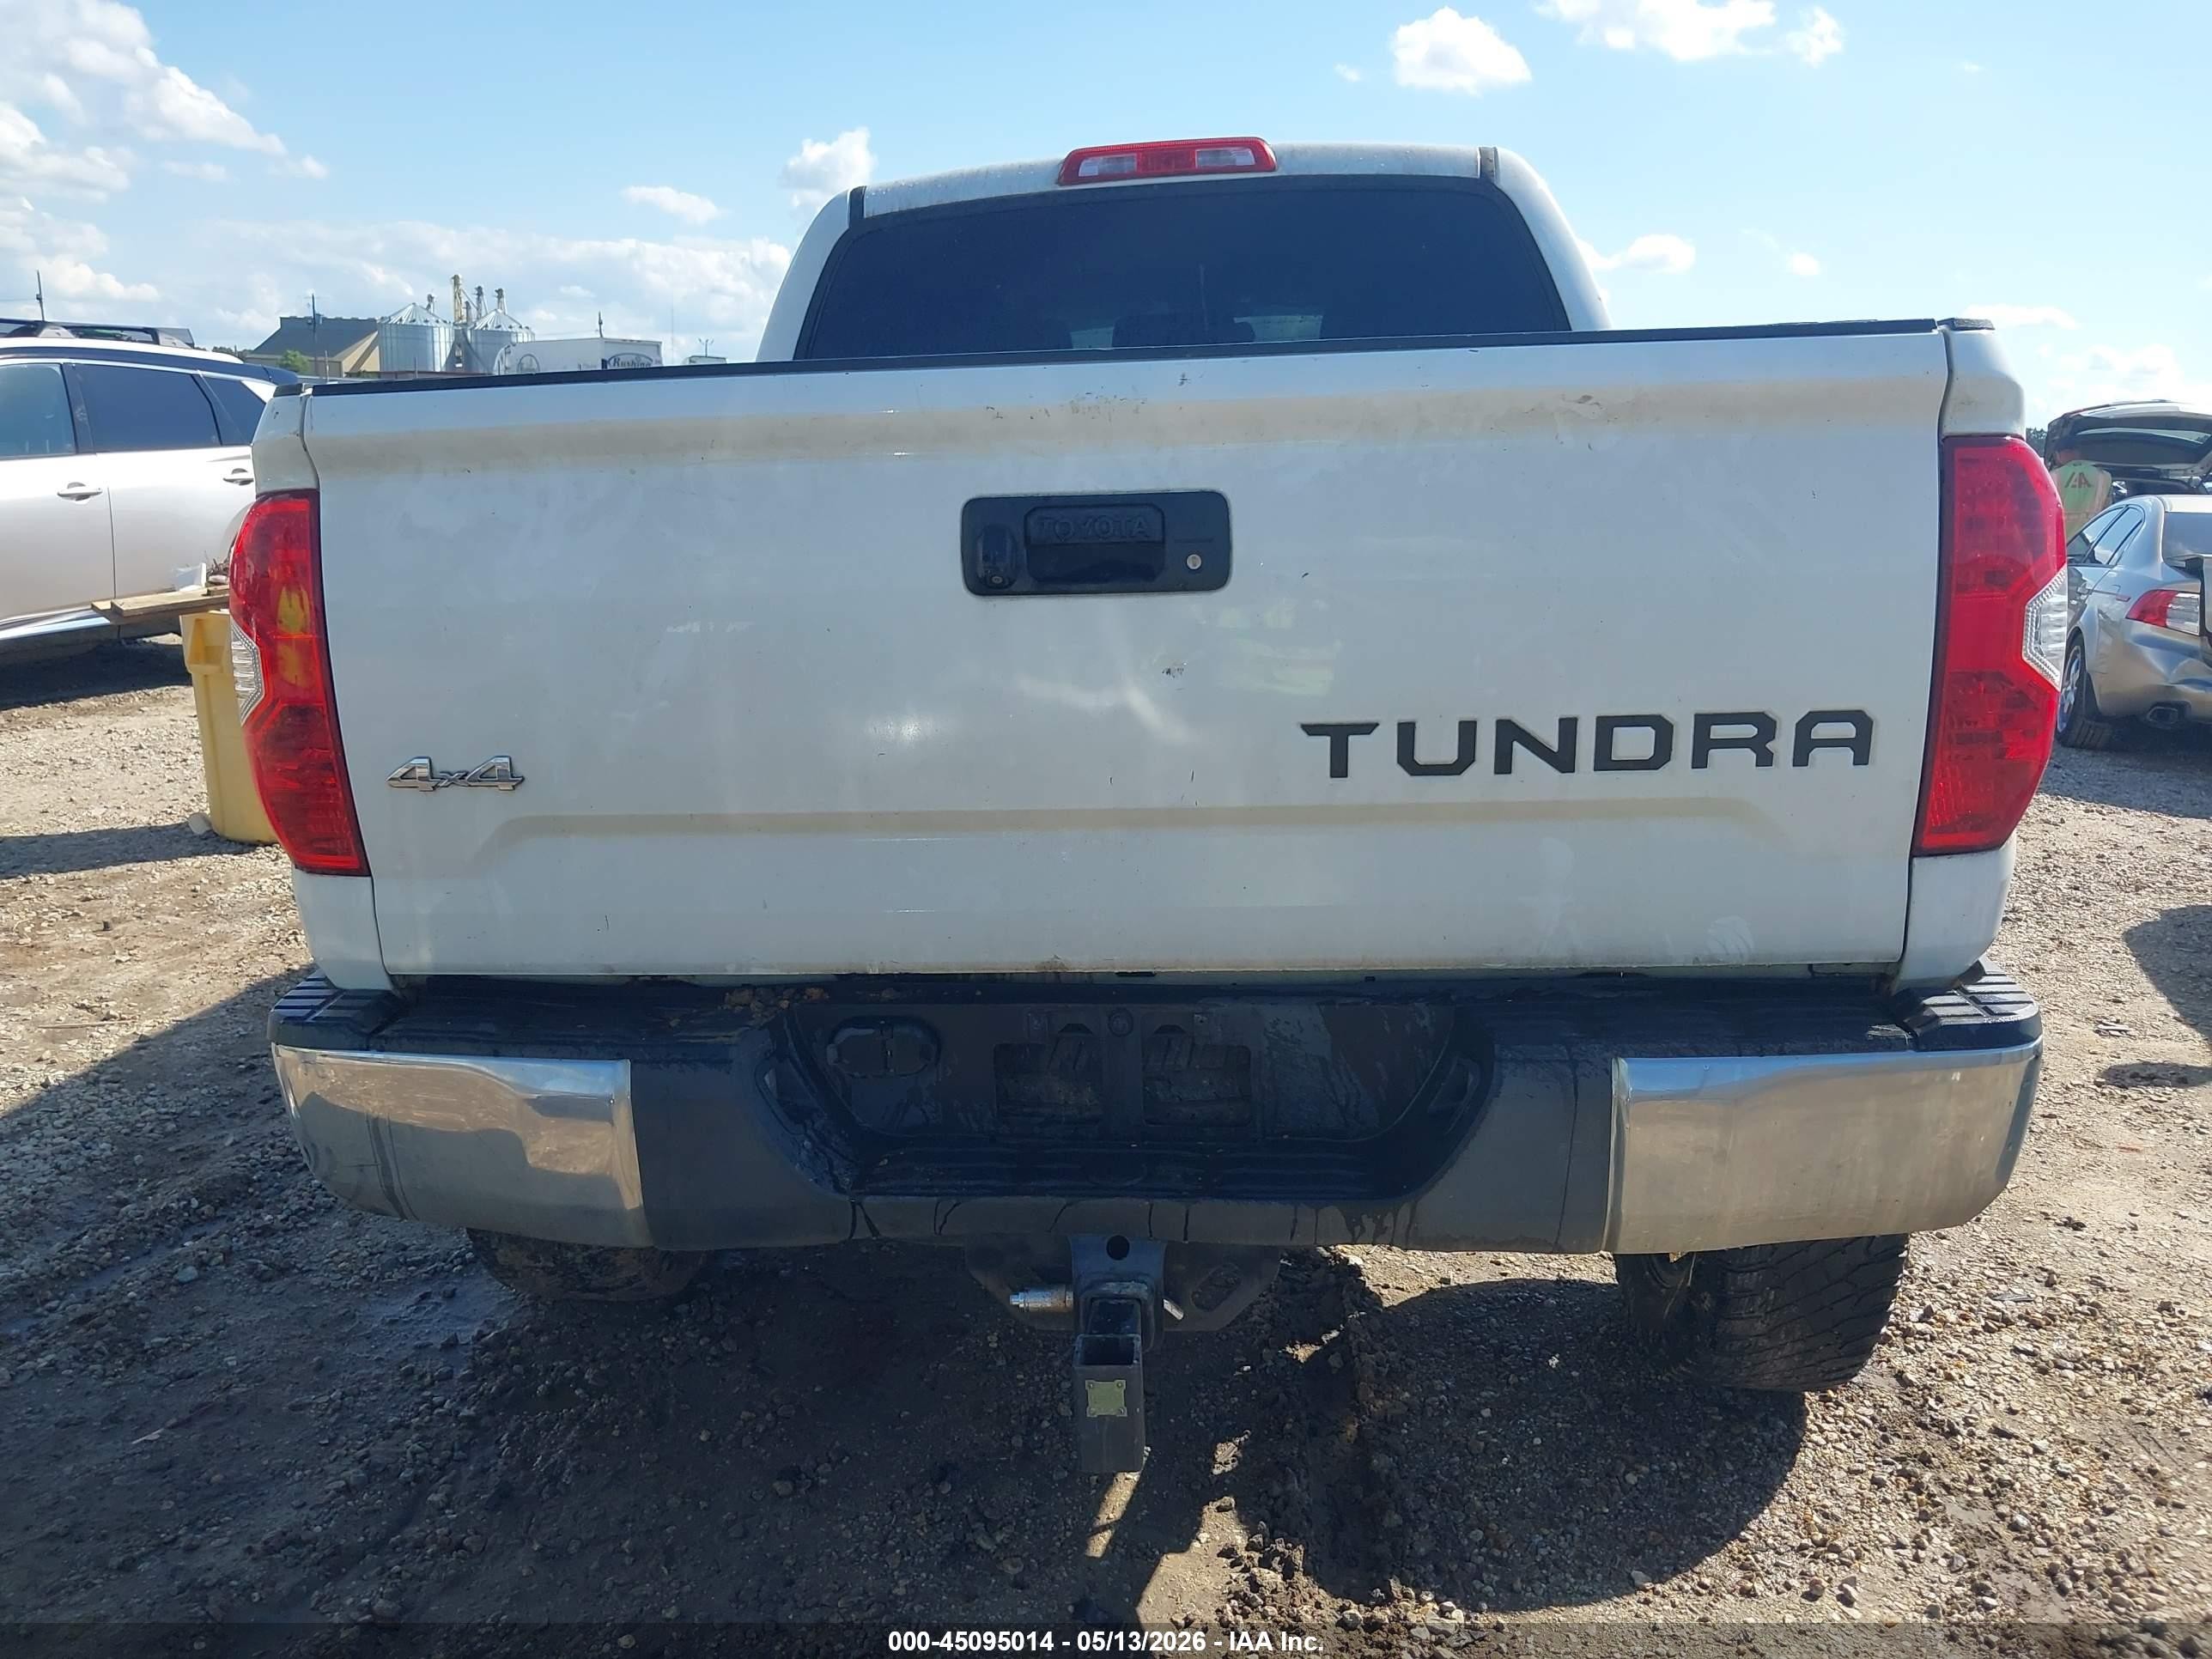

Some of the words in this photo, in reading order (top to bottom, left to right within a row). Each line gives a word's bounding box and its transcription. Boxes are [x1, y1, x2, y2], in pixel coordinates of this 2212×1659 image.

[1039, 515, 1149, 541] TOYOTA
[1299, 709, 1875, 778] TUNDRA
[386, 755, 525, 792] 4x4
